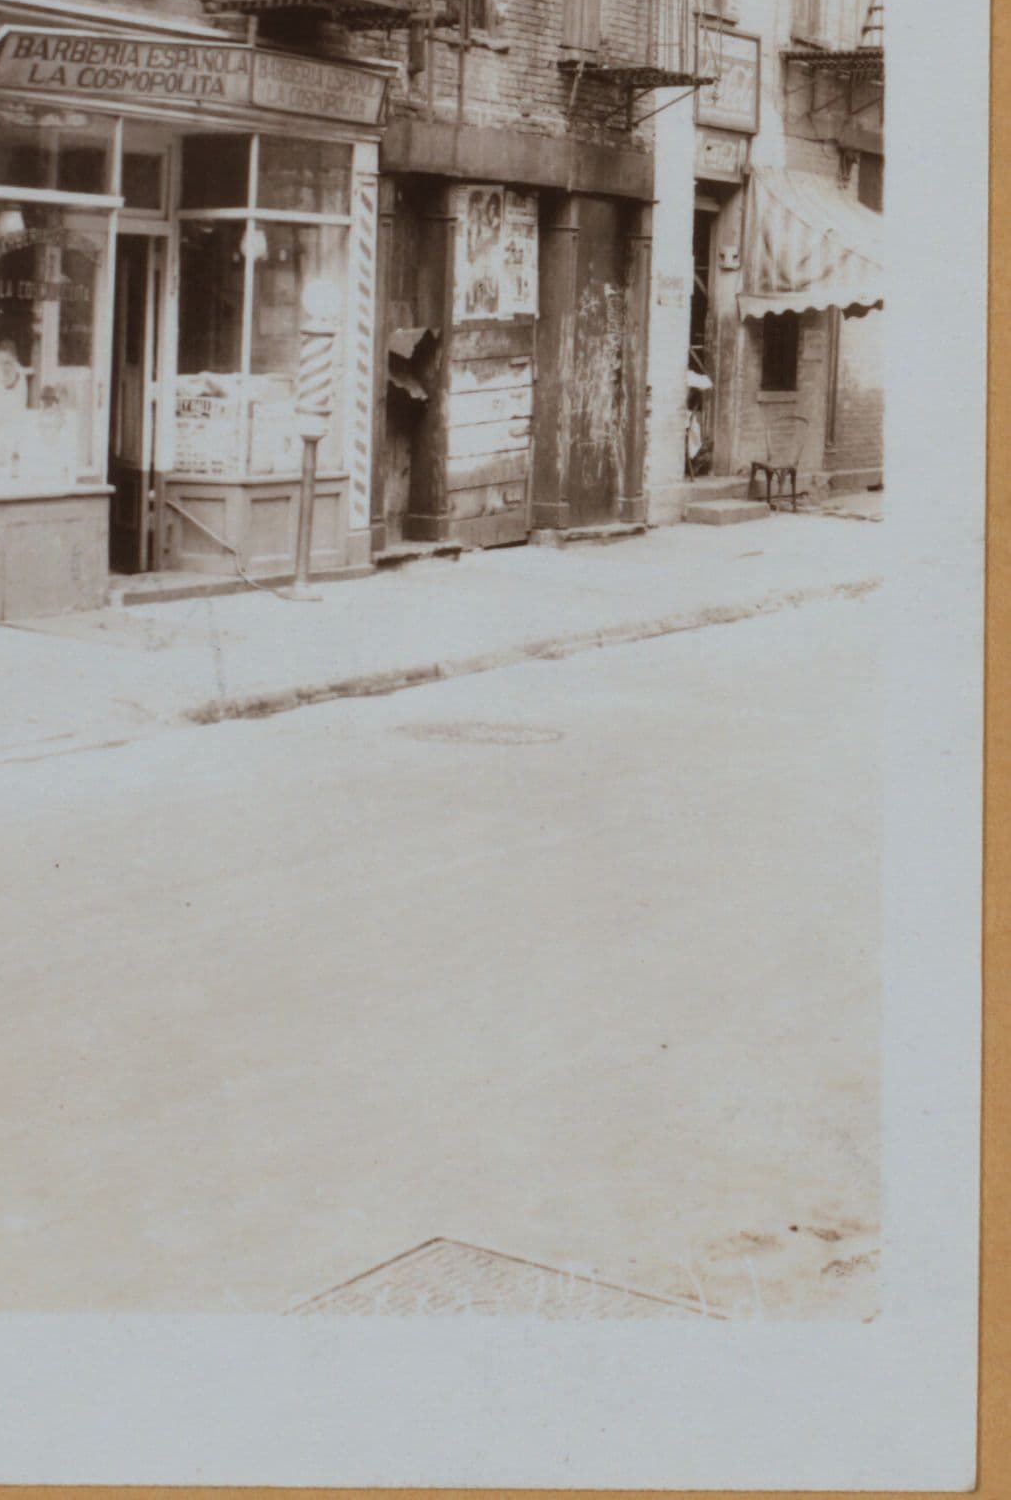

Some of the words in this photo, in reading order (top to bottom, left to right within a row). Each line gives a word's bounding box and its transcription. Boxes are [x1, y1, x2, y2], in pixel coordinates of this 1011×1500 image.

[13, 35, 139, 69] BARBERIA
[28, 62, 67, 87] LA
[77, 67, 225, 97] COSMOPOLITA
